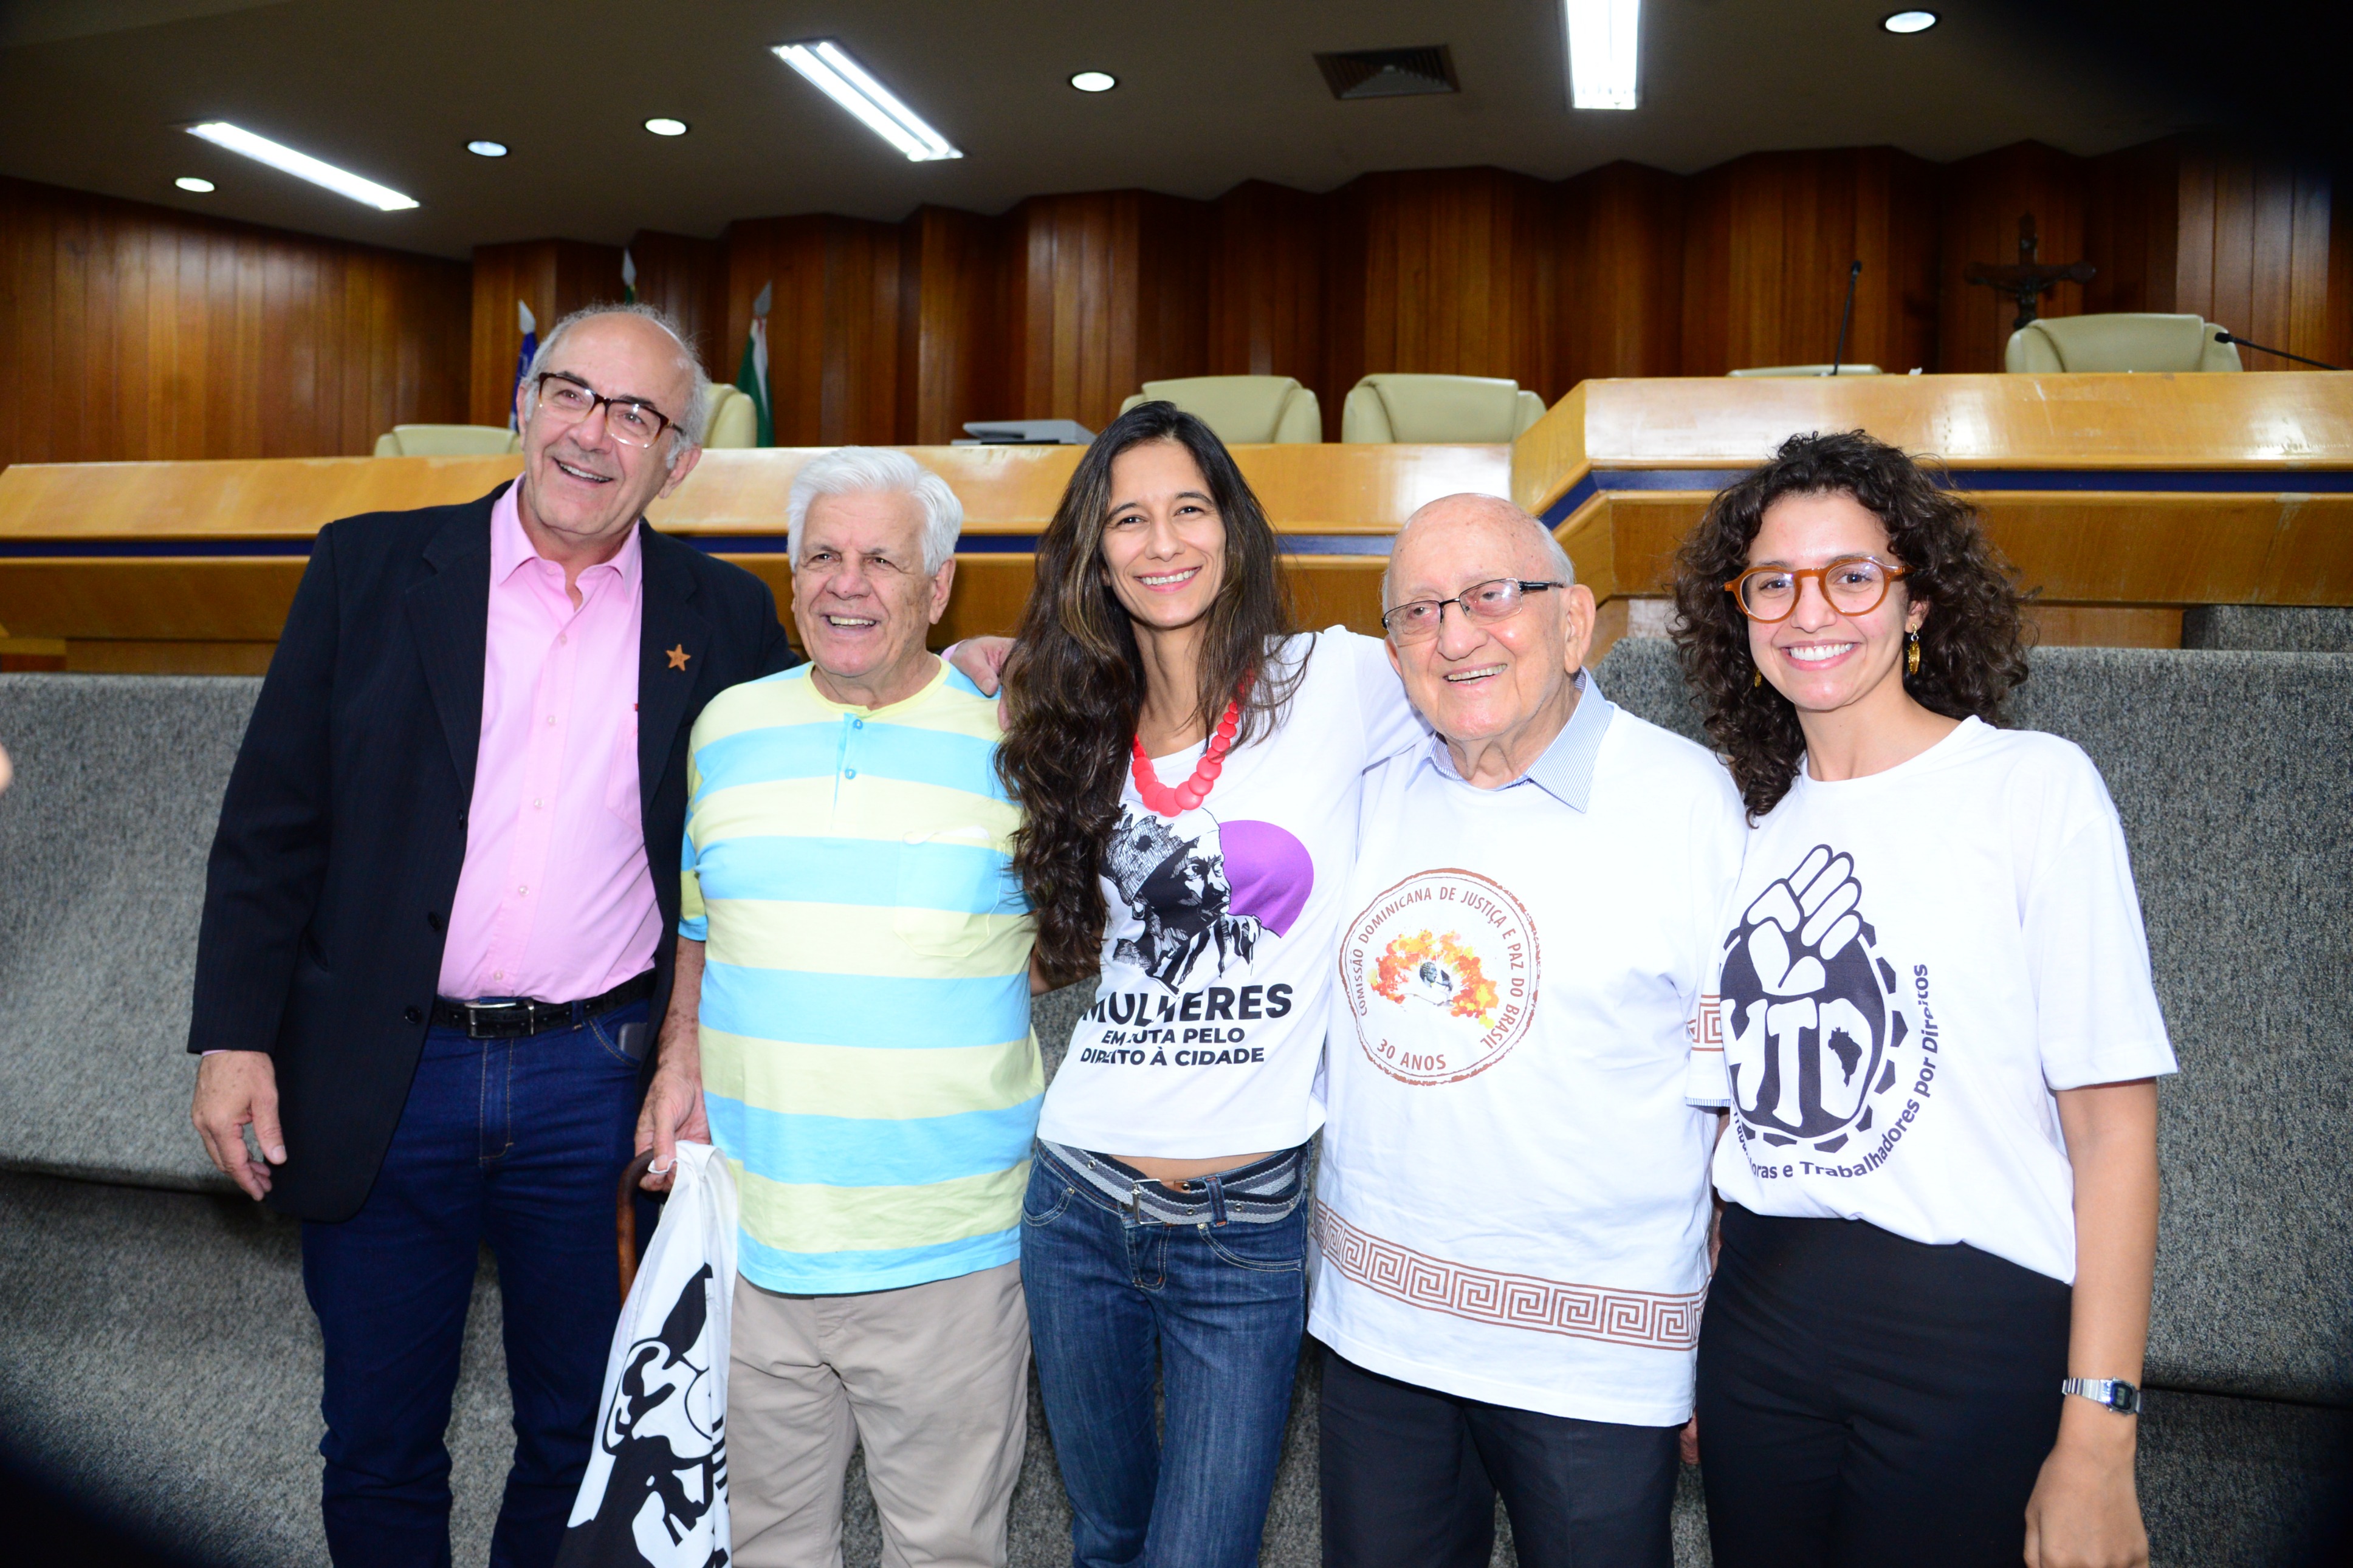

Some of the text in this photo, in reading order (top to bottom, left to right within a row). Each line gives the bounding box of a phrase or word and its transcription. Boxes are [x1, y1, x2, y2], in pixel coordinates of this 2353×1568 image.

[1348, 886, 1525, 1049] COMISSÃO DOMINICANA DE JUSTIÇA E PAZ DO BRASIL
[1082, 983, 1293, 1027] MULHERES
[1101, 1030, 1124, 1046] EM
[1183, 1027, 1245, 1044] PELO
[1377, 1039, 1446, 1071] 30 ANOS
[1149, 1046, 1167, 1066] À
[1174, 1047, 1265, 1066] CIDADE
[1799, 1098, 1920, 1177] Trabalhadores
[1913, 1056, 1937, 1098] por
